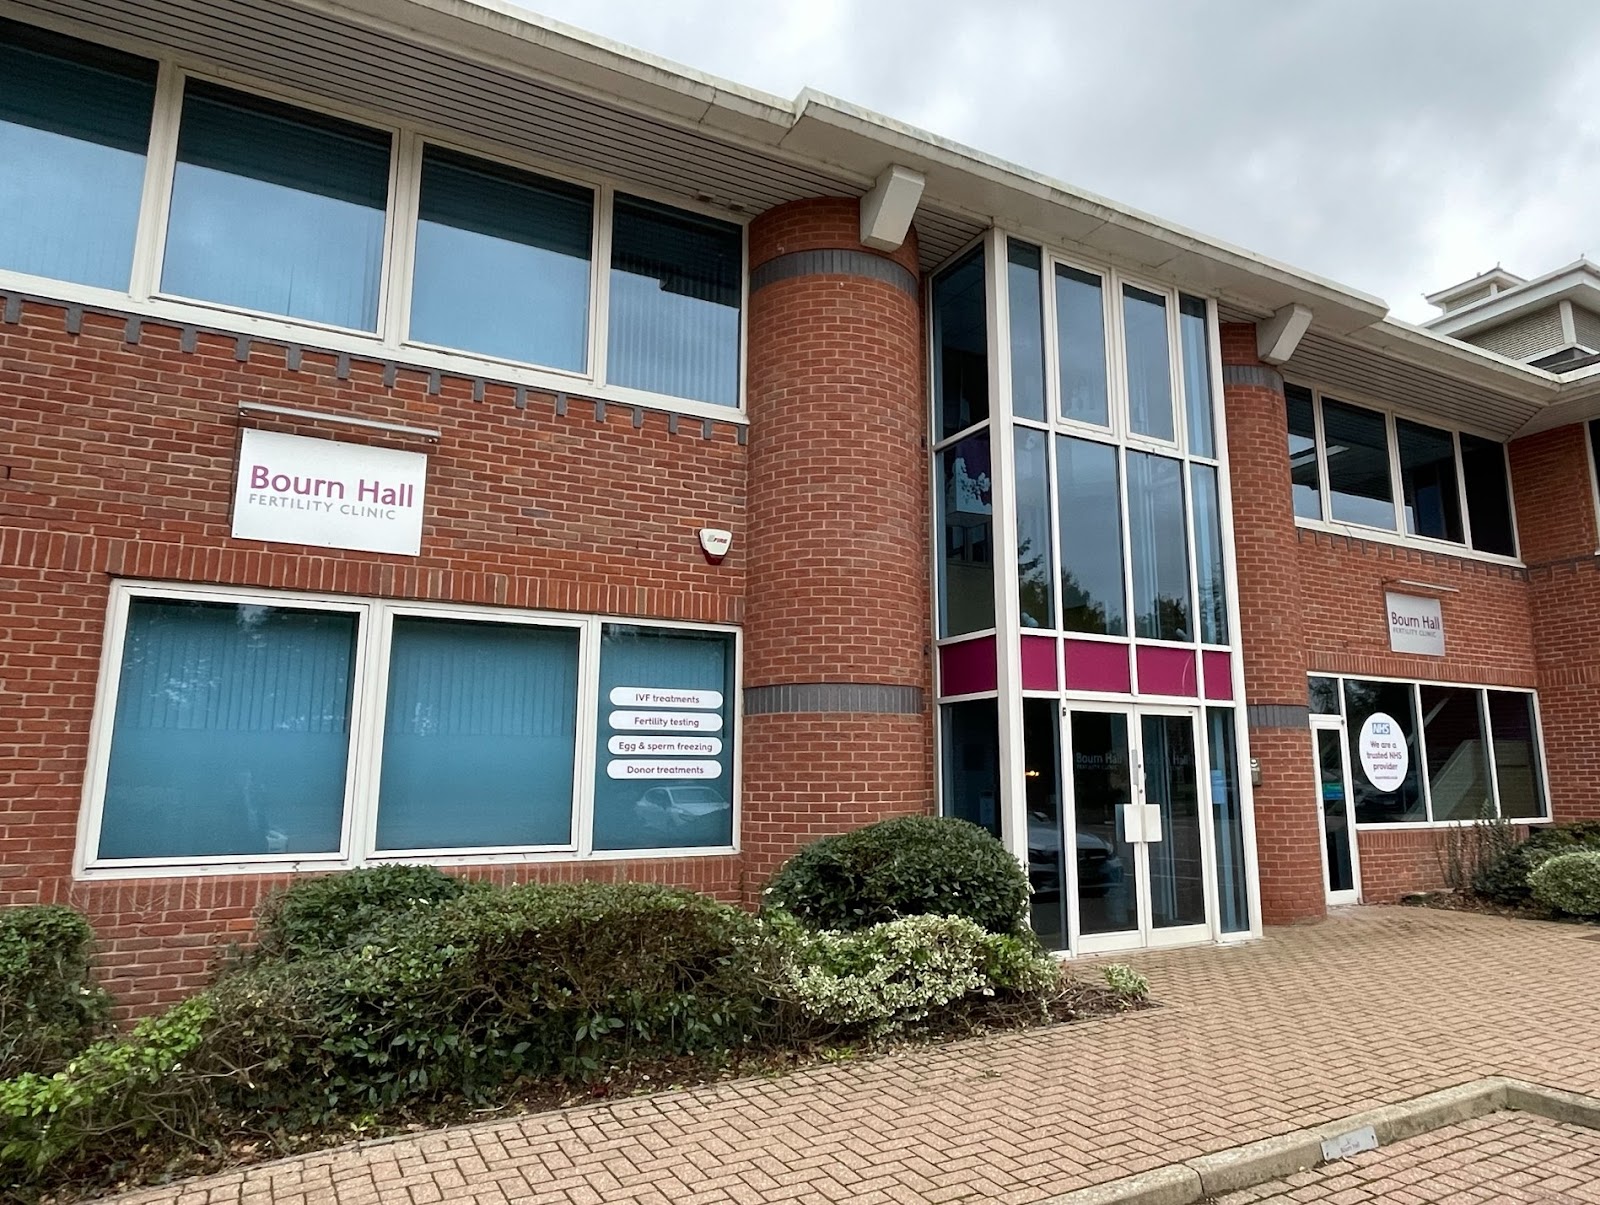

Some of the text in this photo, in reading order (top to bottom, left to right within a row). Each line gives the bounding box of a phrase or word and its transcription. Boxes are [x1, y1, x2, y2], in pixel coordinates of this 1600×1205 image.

[250, 465, 413, 507] Bourn Hall
[249, 494, 396, 520] FERTILITY CLINIC
[1391, 612, 1440, 630] Bourn Hall
[653, 695, 700, 703] treatments
[634, 717, 699, 728] Fertility testing
[1372, 723, 1390, 734] NHS
[618, 742, 712, 752] Egg & sperm freezing
[627, 766, 704, 774] Donor treatments
